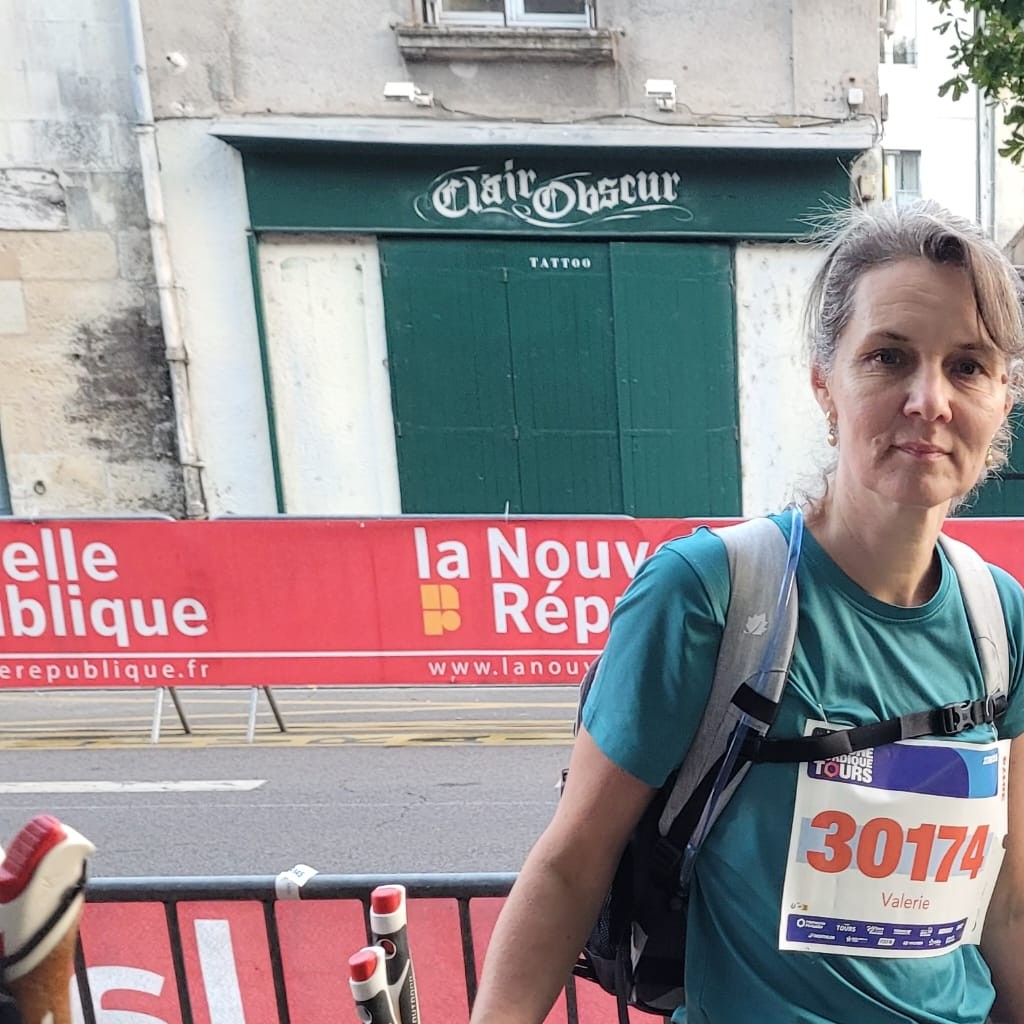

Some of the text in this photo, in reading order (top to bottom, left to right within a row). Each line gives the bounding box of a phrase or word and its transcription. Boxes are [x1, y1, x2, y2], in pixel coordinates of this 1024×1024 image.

[430, 160, 681, 220] Clair Obscur
[529, 257, 592, 269] TATTOO
[413, 527, 662, 581] la Nouv
[0, 583, 209, 647] blique
[492, 581, 622, 644] Rép
[813, 760, 874, 784] TOURS
[806, 810, 990, 883] 30174
[881, 891, 930, 910] Valerie
